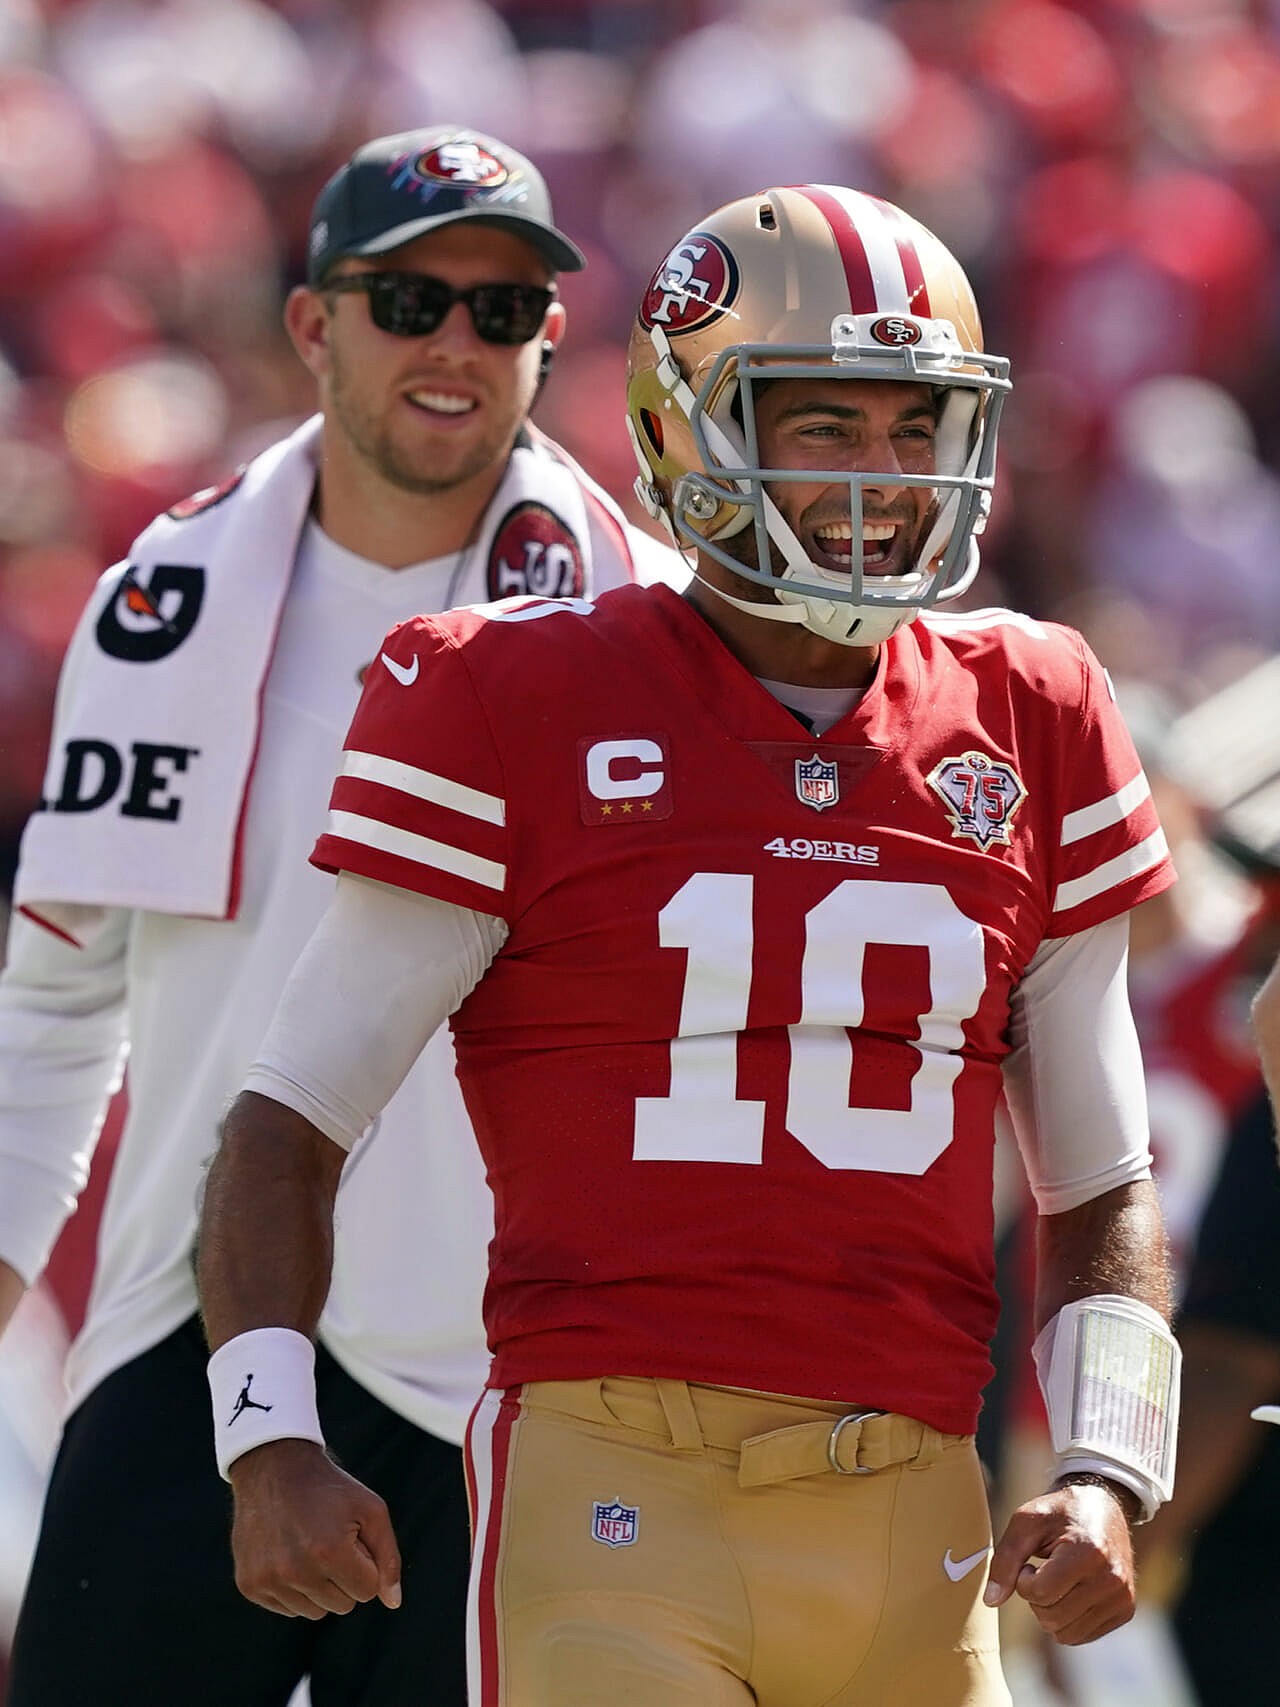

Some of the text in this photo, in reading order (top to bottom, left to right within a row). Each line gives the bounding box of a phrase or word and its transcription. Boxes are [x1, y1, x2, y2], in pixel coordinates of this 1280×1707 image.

[649, 244, 710, 323] SF
[886, 319, 914, 343] SF
[39, 738, 188, 823] DE
[586, 739, 664, 800] C
[802, 779, 833, 801] NFL
[952, 771, 1006, 824] 75
[763, 837, 879, 866] 49ERS
[632, 872, 986, 1176] 10
[599, 1519, 631, 1540] NFL
